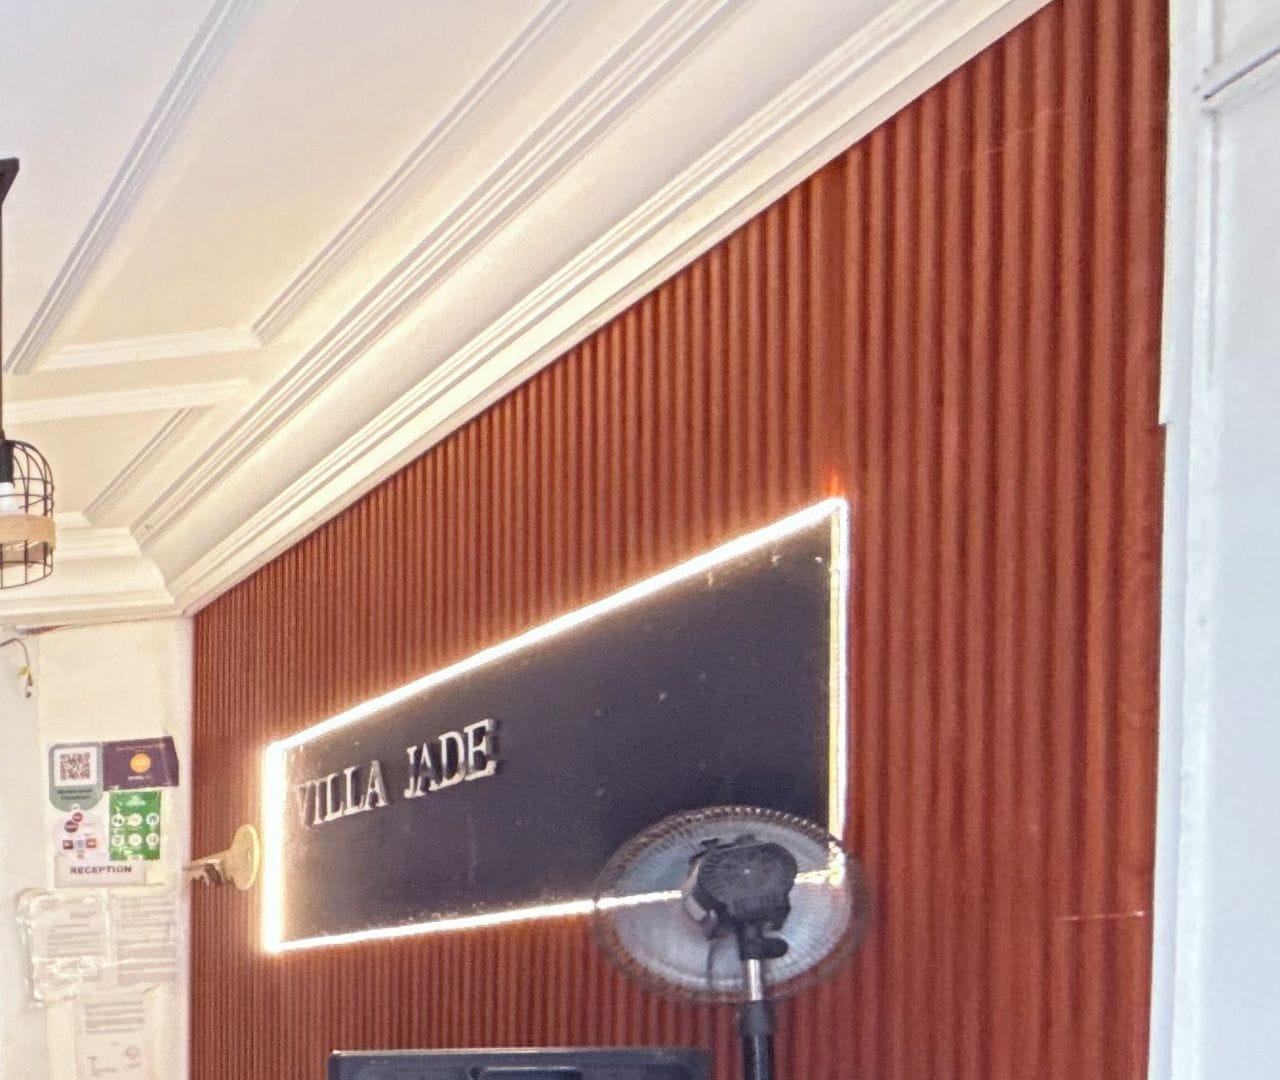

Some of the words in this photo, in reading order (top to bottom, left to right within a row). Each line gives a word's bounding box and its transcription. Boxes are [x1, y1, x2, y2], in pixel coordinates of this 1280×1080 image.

[294, 760, 389, 829] VILLA
[404, 718, 497, 798] JADE
[70, 865, 132, 874] RECEPTION
